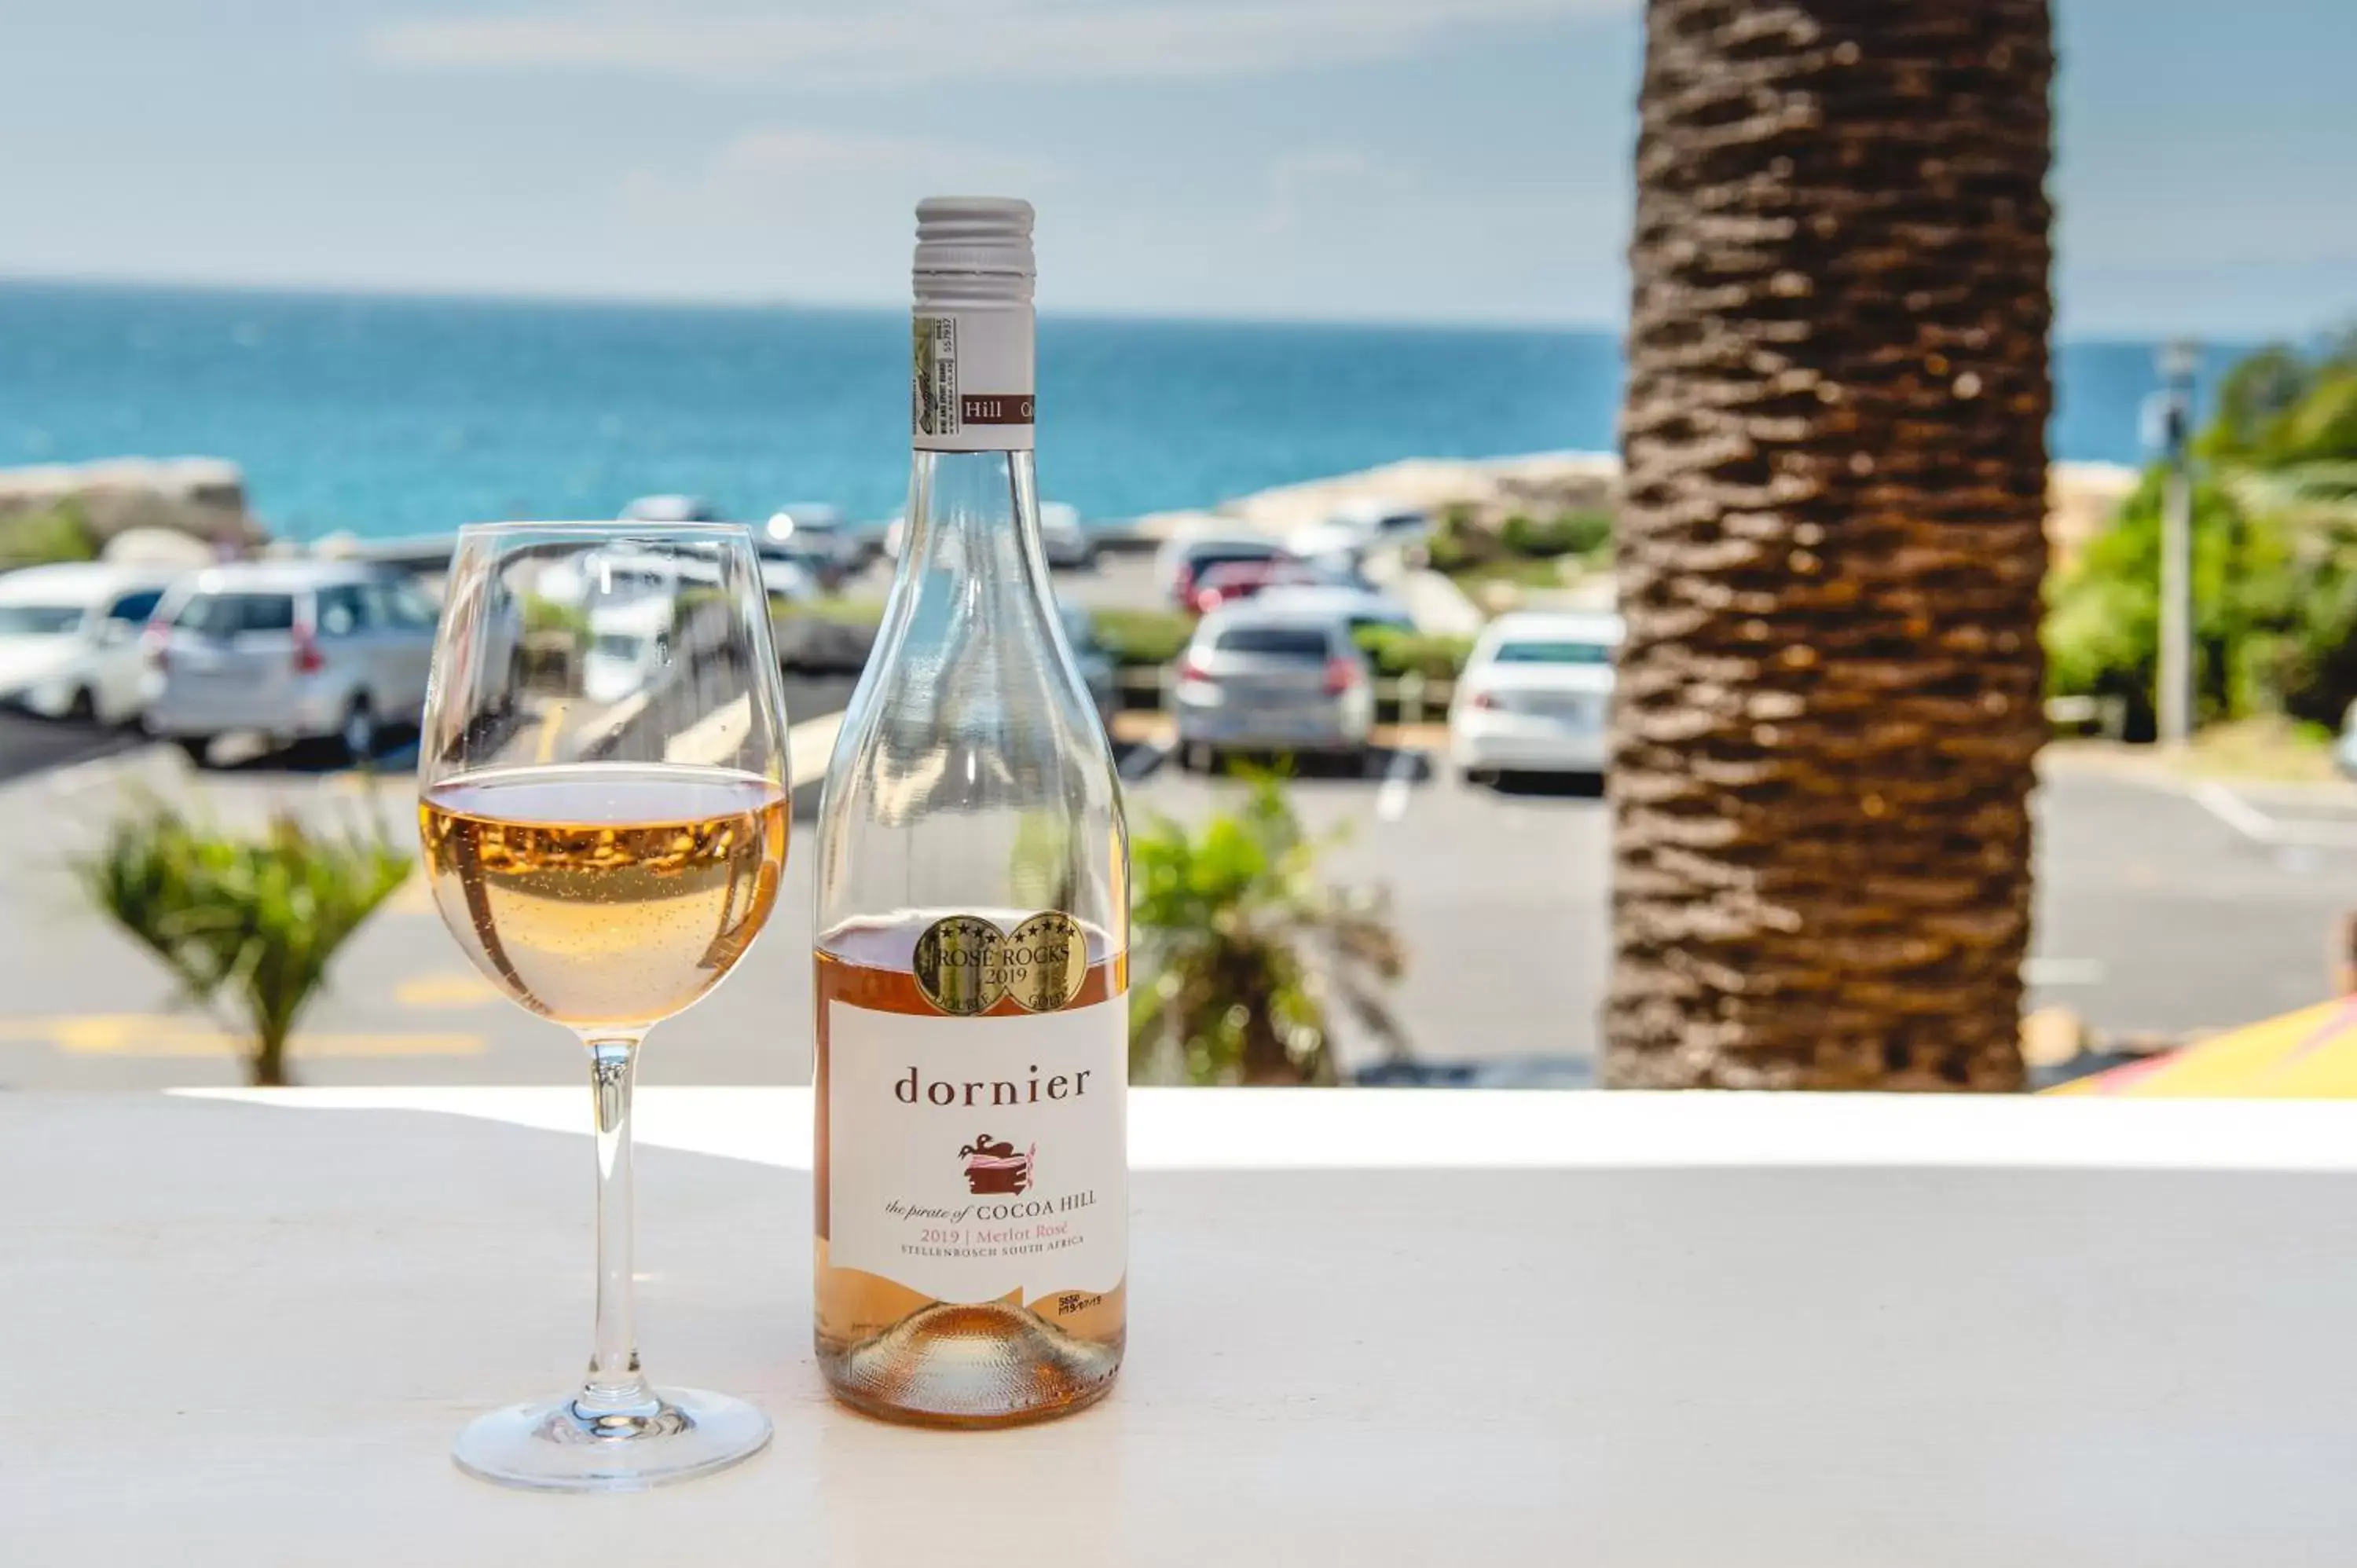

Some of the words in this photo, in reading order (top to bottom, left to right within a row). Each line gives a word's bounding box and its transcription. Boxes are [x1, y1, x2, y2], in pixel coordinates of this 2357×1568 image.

[966, 401, 1001, 417] Hill
[1003, 944, 1069, 966] ROCKS
[985, 967, 1027, 984] 2019
[895, 1064, 1091, 1106] dornier
[885, 1200, 904, 1214] the
[904, 1204, 948, 1219] pirate
[951, 1204, 975, 1223] of
[977, 1200, 1054, 1221] COCOA
[1061, 1189, 1096, 1213] HILL
[920, 1229, 959, 1244] 2019
[977, 1226, 1029, 1244] Merlot
[1036, 1221, 1068, 1238] Rosé
[901, 1244, 997, 1258] STELLENBOSCH
[1002, 1244, 1043, 1257] SOUTH
[1047, 1235, 1084, 1251] AFRICA
